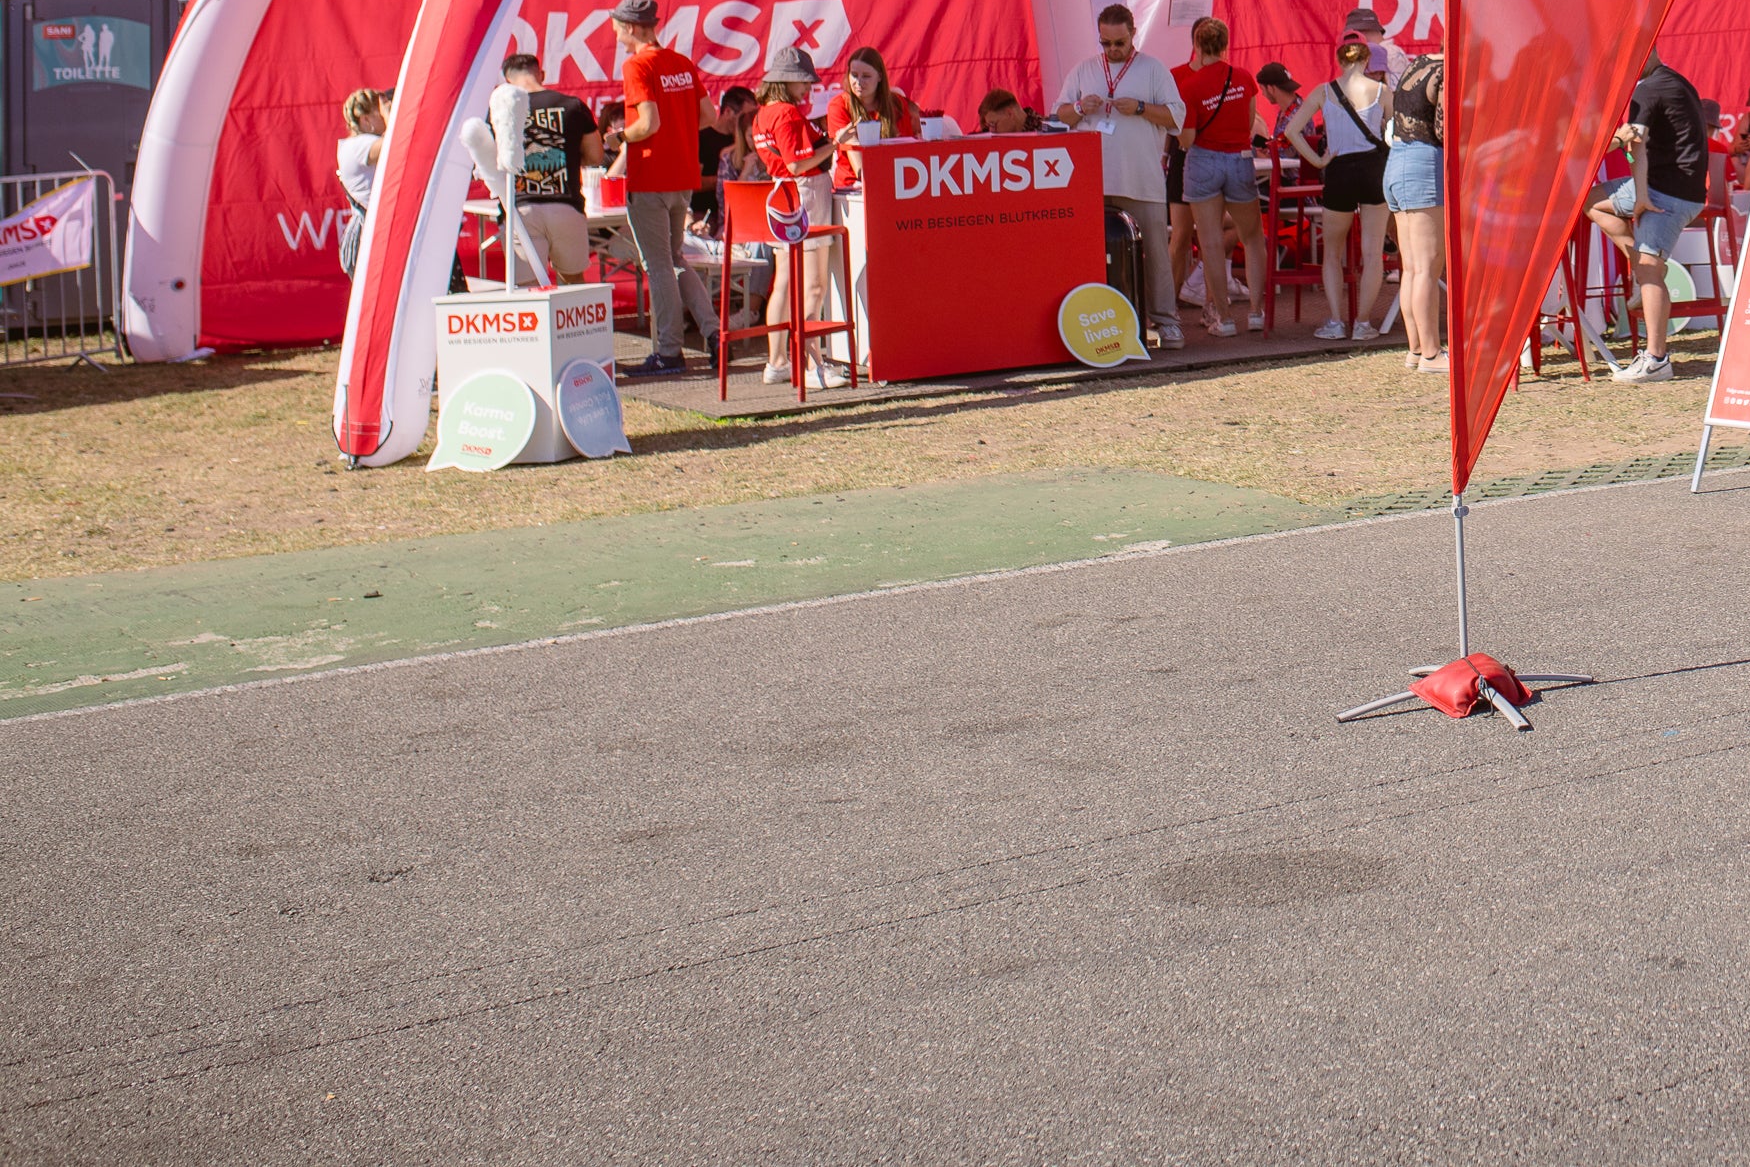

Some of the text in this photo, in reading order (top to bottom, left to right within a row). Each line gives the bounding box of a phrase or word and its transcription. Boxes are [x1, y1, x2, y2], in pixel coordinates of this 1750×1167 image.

[46, 26, 72, 36] SANI
[53, 66, 120, 80] TOILETTE
[536, 107, 565, 134] GET
[527, 167, 567, 195] OST
[894, 149, 1032, 200] DKMS
[896, 207, 1075, 231] WIR BESIEGEN BLUTKREBS
[448, 312, 516, 335] DKMS
[556, 305, 595, 330] DKMS
[1078, 308, 1116, 327] Save
[448, 336, 539, 345] WIR BESIEGEN BLUTKREBS
[1084, 325, 1124, 344] lives.
[463, 401, 516, 421] Karma
[458, 420, 506, 441] Boost.
[461, 444, 484, 455] DKMS
